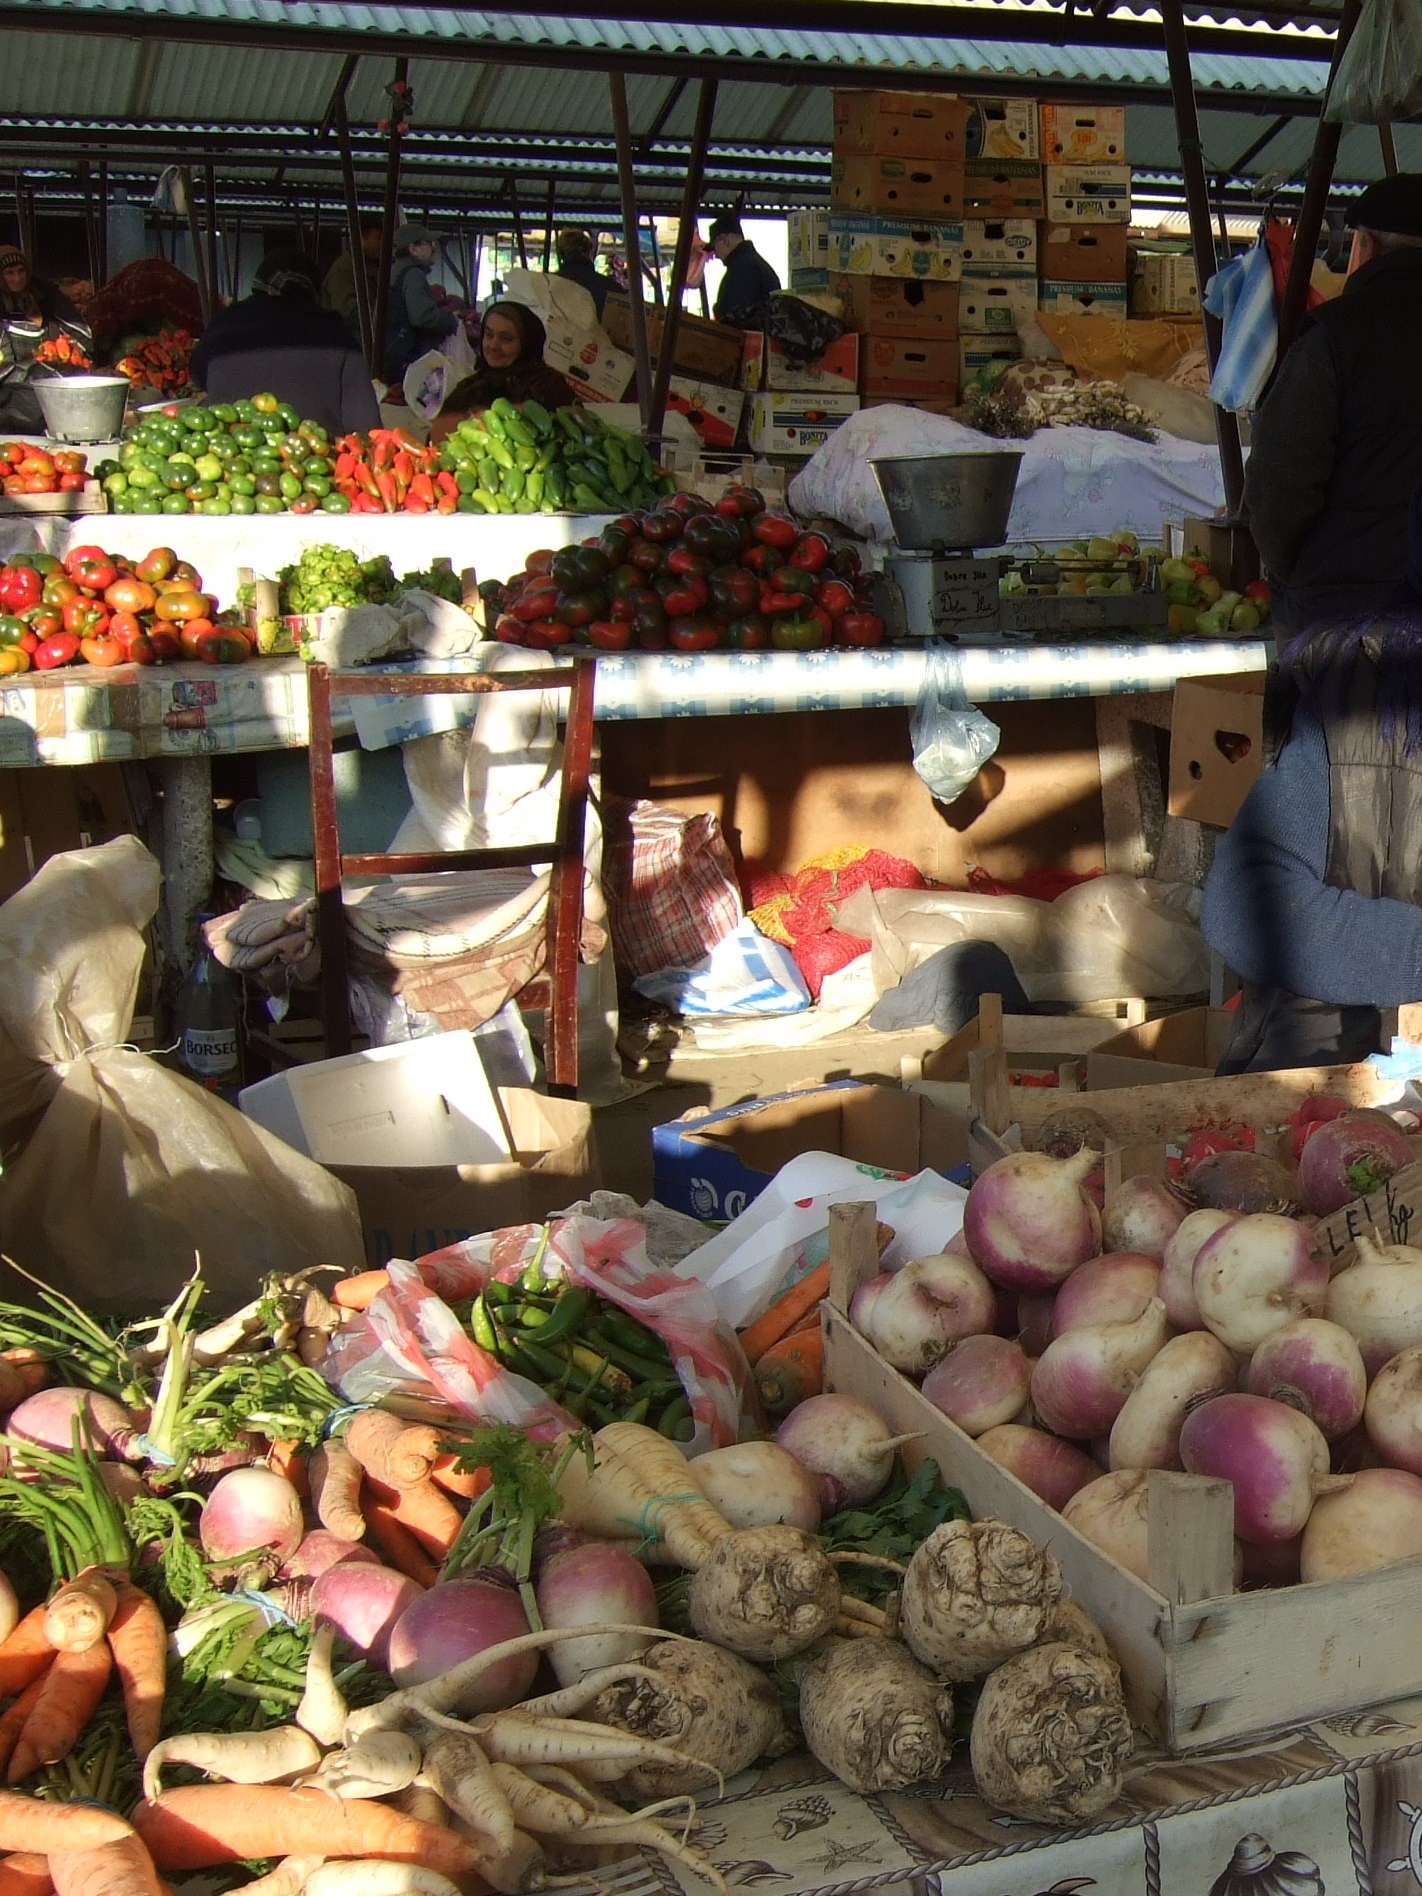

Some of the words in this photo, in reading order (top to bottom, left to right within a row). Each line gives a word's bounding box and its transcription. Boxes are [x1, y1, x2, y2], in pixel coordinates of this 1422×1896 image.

[799, 431, 828, 446] BONITA
[186, 1040, 237, 1056] BORSEC
[1327, 1194, 1373, 1256] LEI
